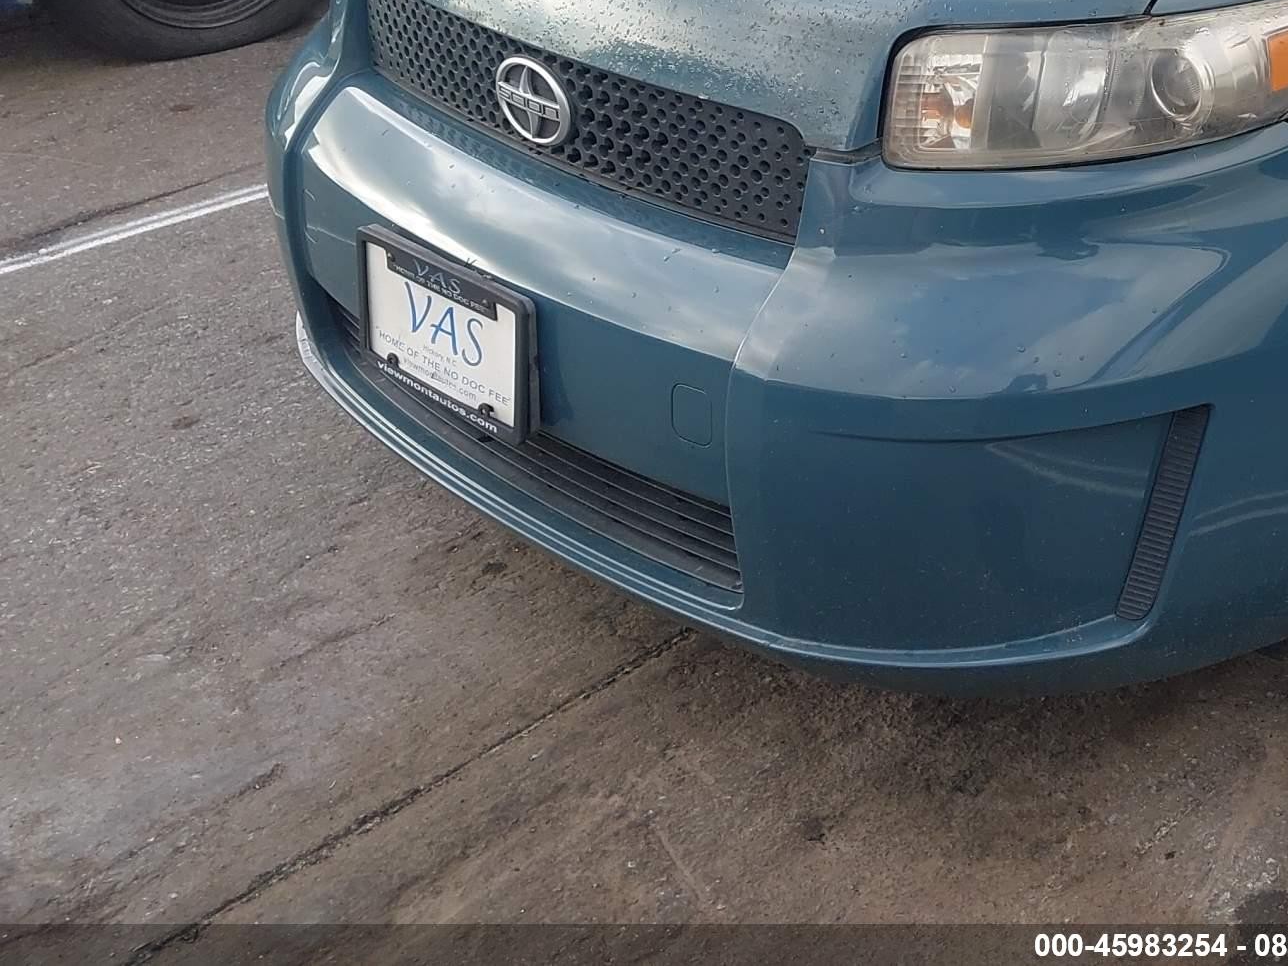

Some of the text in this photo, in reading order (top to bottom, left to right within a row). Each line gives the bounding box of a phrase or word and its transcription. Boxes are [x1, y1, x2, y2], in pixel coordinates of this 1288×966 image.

[414, 259, 460, 294] VAS
[404, 280, 484, 367] VAS
[377, 360, 498, 433] viewmontautos.com
[406, 347, 420, 359] OF
[422, 354, 441, 372] THE
[443, 369, 459, 381] NO
[462, 376, 486, 393] DOC
